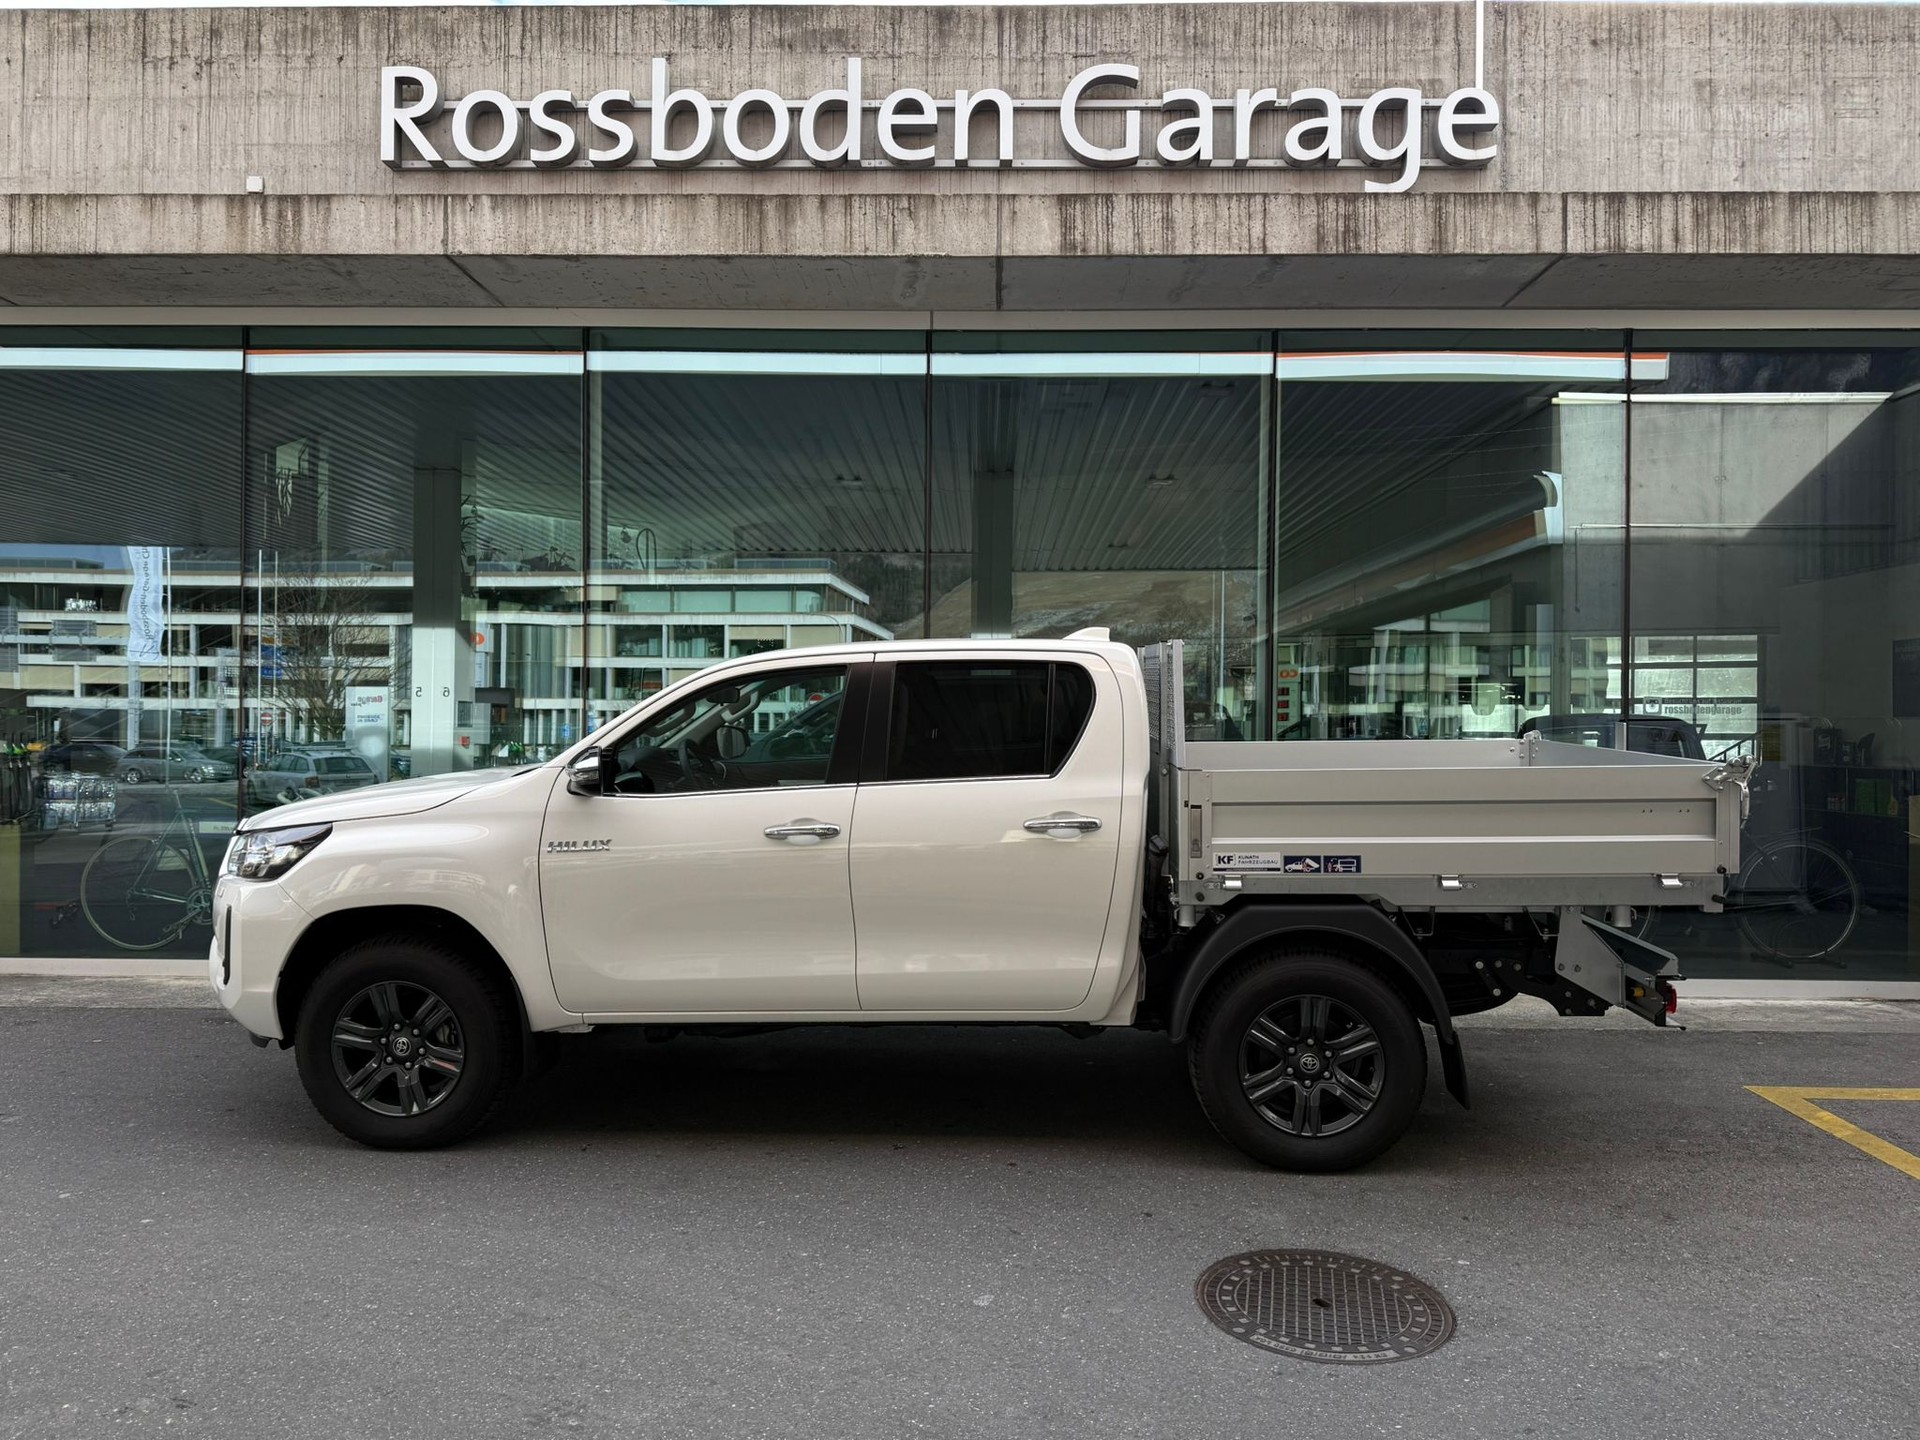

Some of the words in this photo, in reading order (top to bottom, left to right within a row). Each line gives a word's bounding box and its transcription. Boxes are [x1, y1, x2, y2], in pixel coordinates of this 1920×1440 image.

[380, 57, 1014, 168] Rossboden
[1058, 62, 1499, 193] Garage
[546, 839, 612, 853] HILUX
[1217, 855, 1233, 865] KF
